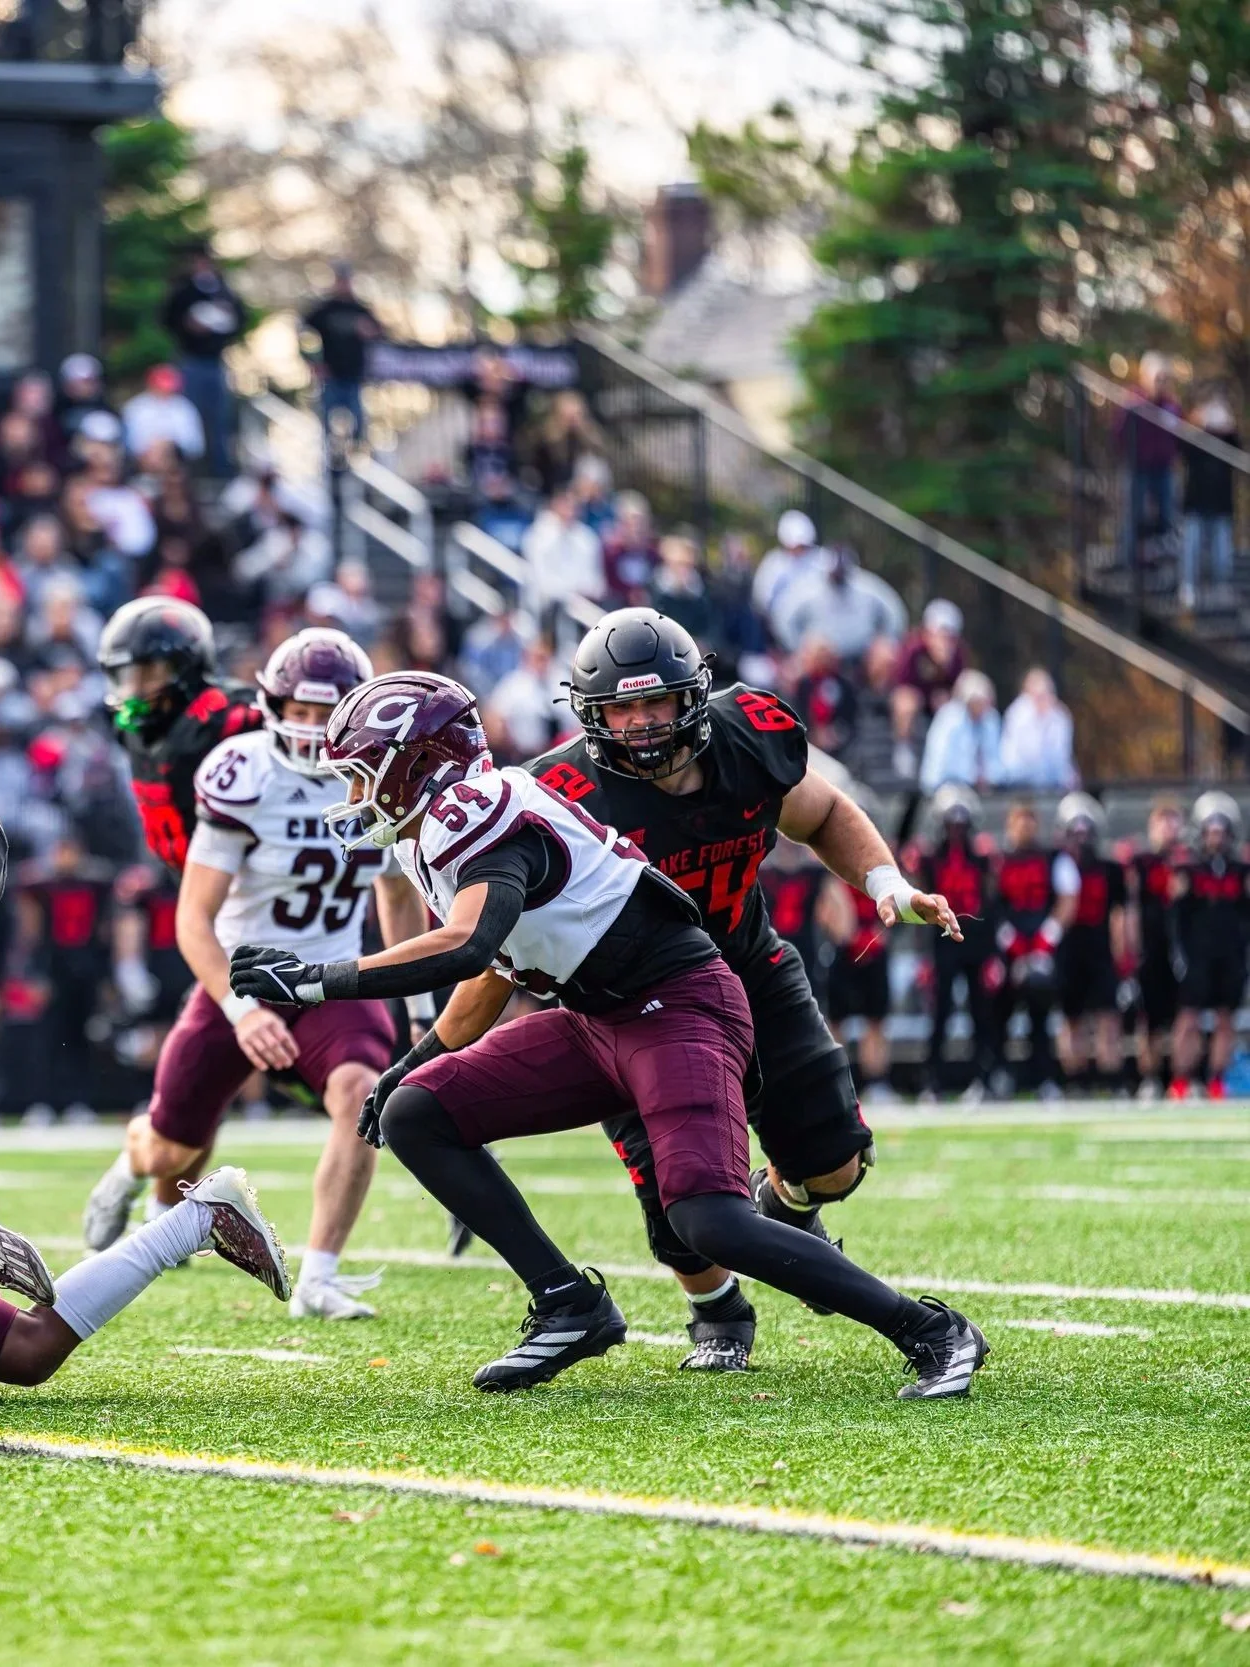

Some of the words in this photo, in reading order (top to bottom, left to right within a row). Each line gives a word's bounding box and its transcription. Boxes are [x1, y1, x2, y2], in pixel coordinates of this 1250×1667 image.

[622, 678, 657, 689] Riddell
[205, 748, 248, 792] 35
[428, 783, 494, 833] 54
[659, 848, 693, 876] AKE
[698, 827, 767, 866] FOREST
[272, 847, 385, 934] 35
